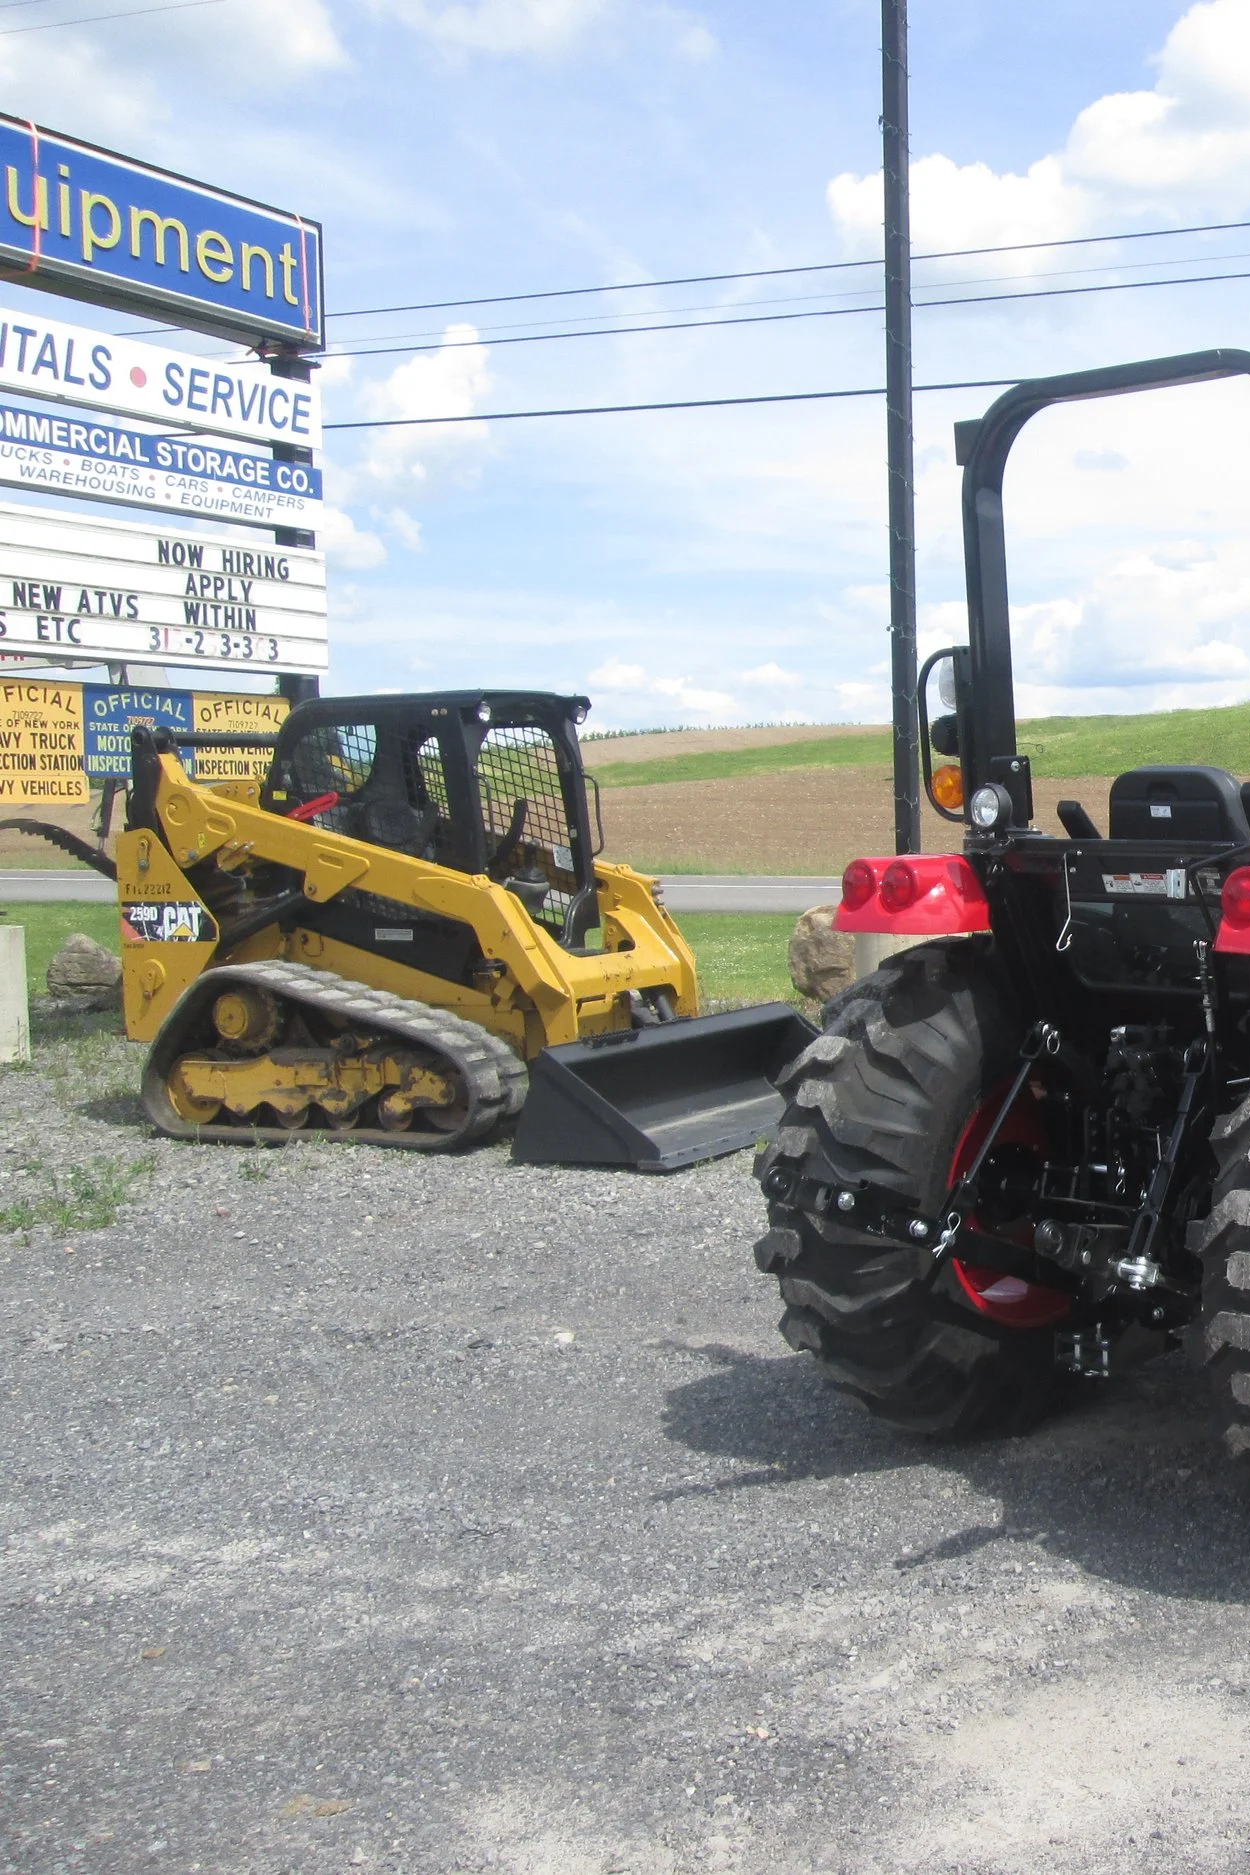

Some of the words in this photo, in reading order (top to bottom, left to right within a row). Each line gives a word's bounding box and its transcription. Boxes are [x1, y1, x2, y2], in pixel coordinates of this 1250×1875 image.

[6, 163, 298, 306] uipment
[162, 362, 312, 435] SERVICE
[0, 411, 150, 463] MMERCIAL
[156, 442, 271, 486] STORAGE
[276, 466, 314, 494] CO.
[20, 464, 156, 499] WAREHOUSING
[180, 493, 274, 519] EQUIPMENT
[80, 459, 140, 481] BOATS
[165, 474, 209, 493] CARS
[232, 487, 306, 510] CAMPERS
[158, 540, 204, 568] NOW
[221, 549, 290, 580] HIRING
[12, 581, 62, 611] NEW
[77, 589, 139, 619] ATVS
[185, 573, 253, 603] APPLY
[36, 615, 82, 644] ETC
[184, 601, 257, 632] WITHIN
[3, 684, 76, 715] FICIAL
[94, 692, 186, 722] OFFICIAL
[200, 699, 282, 726] OFFICIAL
[6, 718, 20, 728] OF
[25, 720, 48, 729] NEW
[52, 720, 80, 730] YORK
[89, 722, 120, 732] STATE
[30, 732, 76, 750] TRUCK
[40, 754, 84, 771] STATION
[195, 759, 250, 775] INSPECTION
[21, 780, 82, 796] VEHICLES
[129, 906, 158, 921] 259D
[163, 906, 201, 941] CAT
